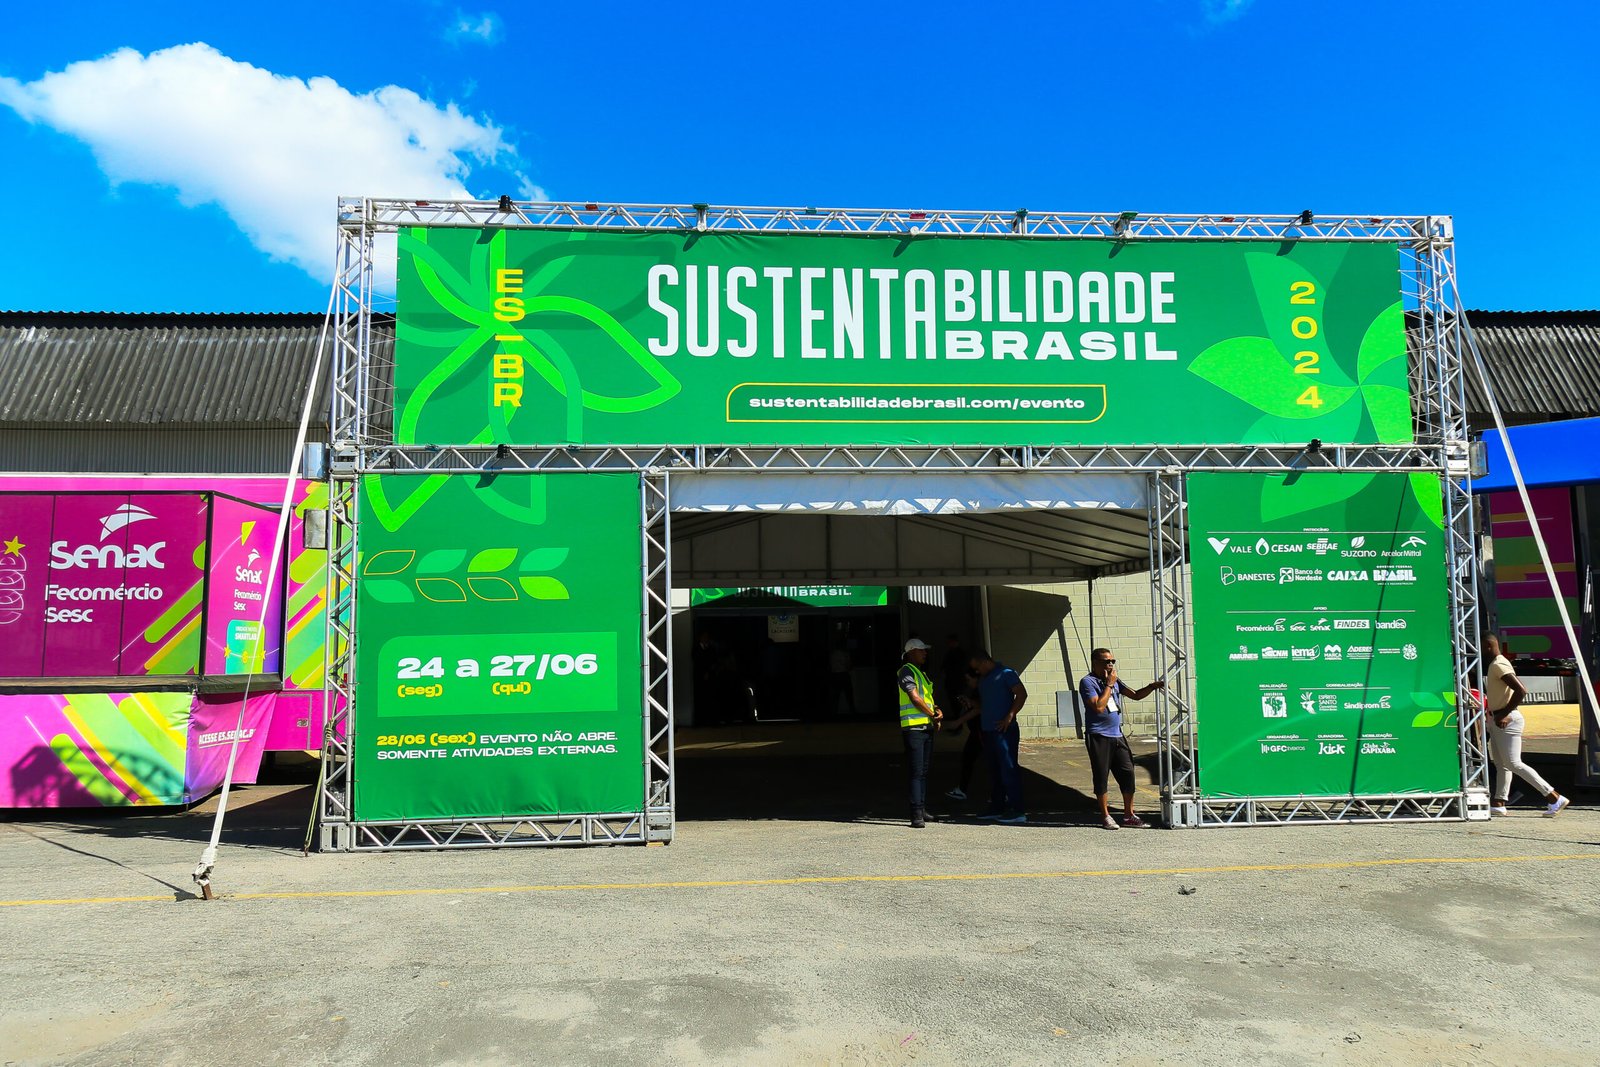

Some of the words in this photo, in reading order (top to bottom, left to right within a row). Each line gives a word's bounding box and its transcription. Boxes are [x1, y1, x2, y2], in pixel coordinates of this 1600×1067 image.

[945, 330, 1178, 360] BRASIL
[1290, 281, 1324, 409] 2024
[749, 396, 1085, 410] sustentabilidadebrasil.com/evento
[1272, 544, 1302, 552] CESAN
[1306, 542, 1338, 550] SEBRAE
[48, 541, 166, 569] Senac
[235, 566, 262, 584] Senac
[1327, 570, 1368, 581] CAIXA
[1373, 570, 1416, 581] BRASIL
[45, 583, 163, 600] Fecomércio
[234, 601, 247, 612] Sesc
[44, 607, 93, 622] Sesc
[1375, 620, 1405, 629] bandes
[1291, 645, 1315, 656] iema
[397, 656, 444, 679] 24
[456, 658, 480, 678] a
[490, 654, 598, 680] 27/06
[397, 684, 443, 697] (seg)
[492, 682, 532, 695] (qui)
[376, 734, 426, 746] 28/06
[430, 732, 476, 746] (sex)
[480, 733, 538, 744] EVENTO
[542, 730, 572, 742] NÃO
[577, 731, 618, 741] ABRE.
[377, 750, 447, 760] SOMENTE
[452, 747, 533, 758] ATIVIDADES
[538, 744, 618, 755] EXTERNAS.
[1318, 742, 1345, 754] kick
